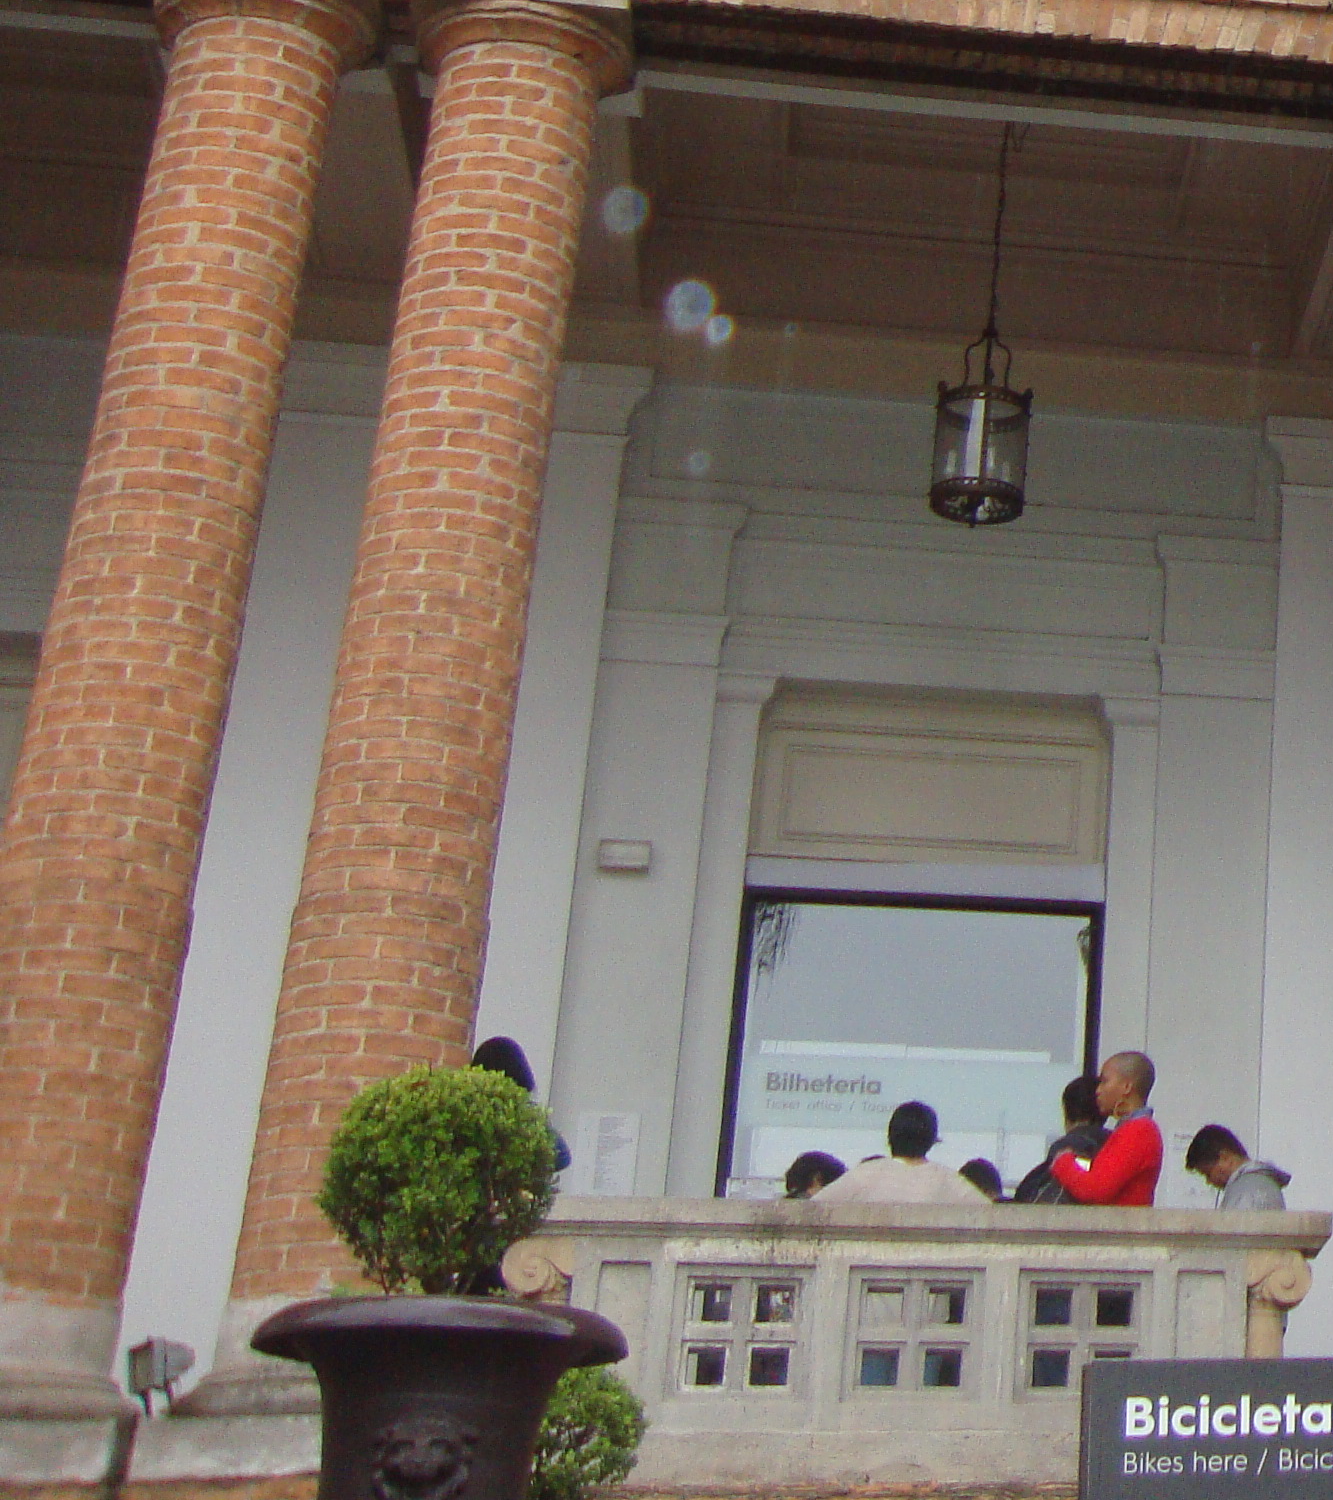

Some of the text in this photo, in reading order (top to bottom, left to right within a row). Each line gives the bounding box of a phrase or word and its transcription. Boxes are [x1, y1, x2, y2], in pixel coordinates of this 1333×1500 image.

[766, 1072, 881, 1094] Bilheteria
[1124, 1452, 1184, 1474] Bikes
[1193, 1450, 1248, 1472] here
[1256, 1448, 1268, 1475] /
